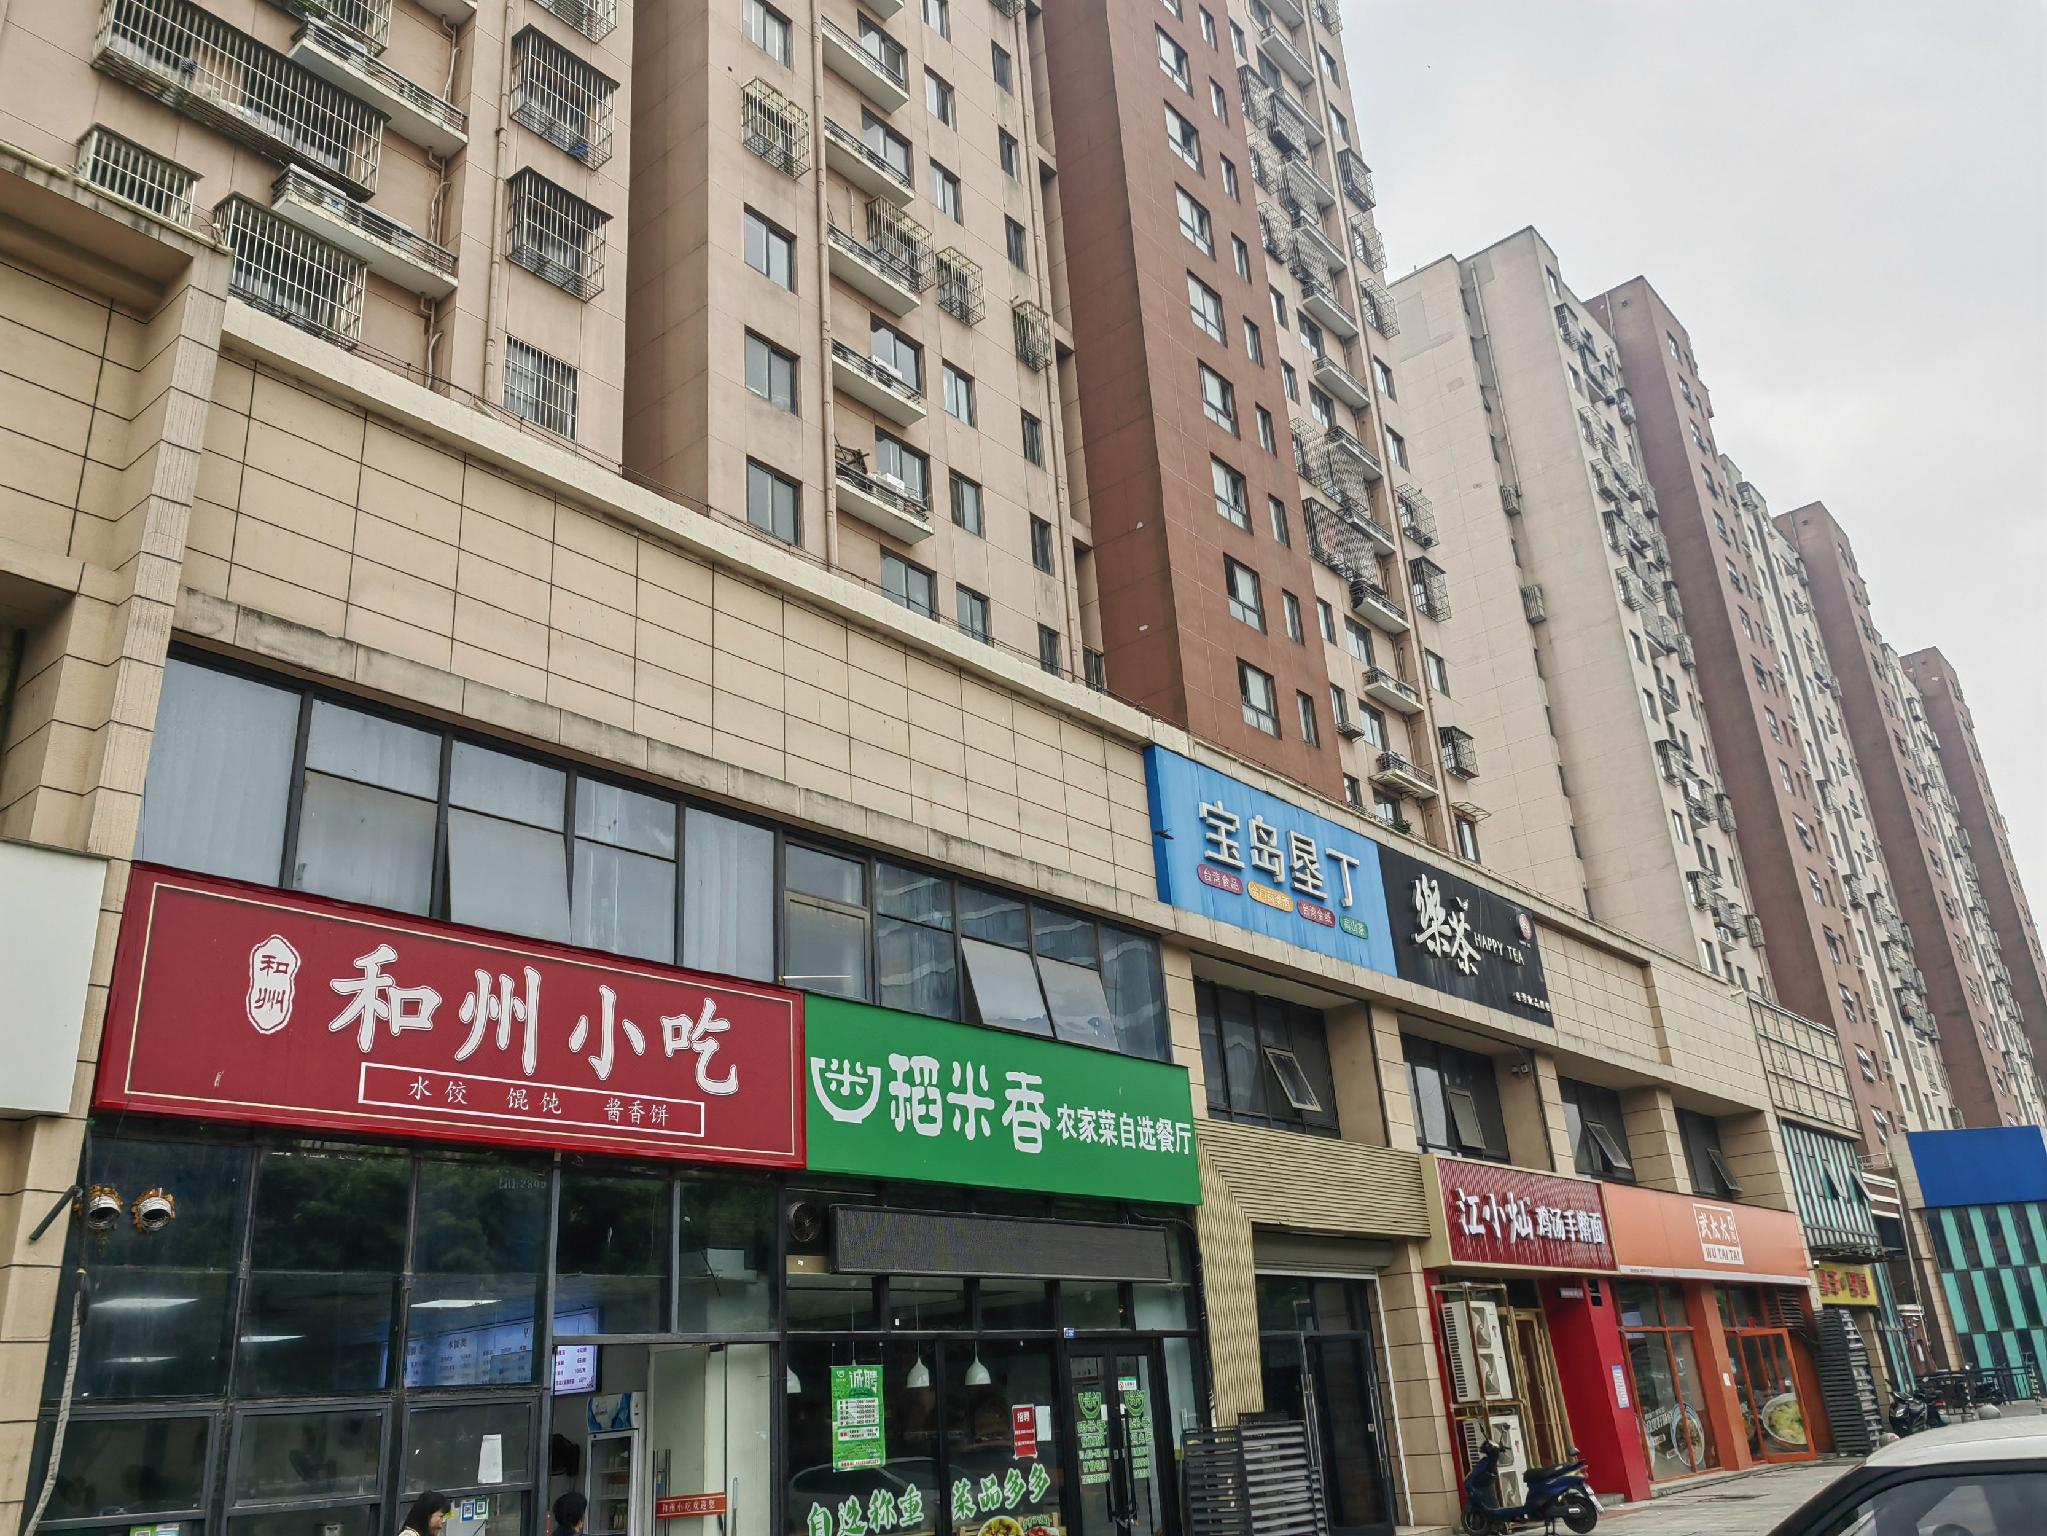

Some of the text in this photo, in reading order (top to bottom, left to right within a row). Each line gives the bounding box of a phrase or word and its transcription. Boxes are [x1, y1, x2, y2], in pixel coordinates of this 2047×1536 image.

[1199, 800, 1360, 907] 宝岛垦丁
[1474, 933, 1504, 957] HAPPY
[1507, 945, 1526, 966] TEA
[254, 953, 290, 1013] 和州
[329, 943, 739, 1095] 和州小吃
[408, 1075, 669, 1127] 水饺 馄饨 酱香饼
[887, 1053, 1050, 1154] 稻米香
[1057, 1104, 1192, 1156] 农家菜自选餐厅
[1705, 1247, 1717, 1259] WU
[848, 1368, 878, 1394] 诚聘
[806, 1483, 925, 1536] 自选称重
[951, 1462, 1050, 1520] 菜品多多
